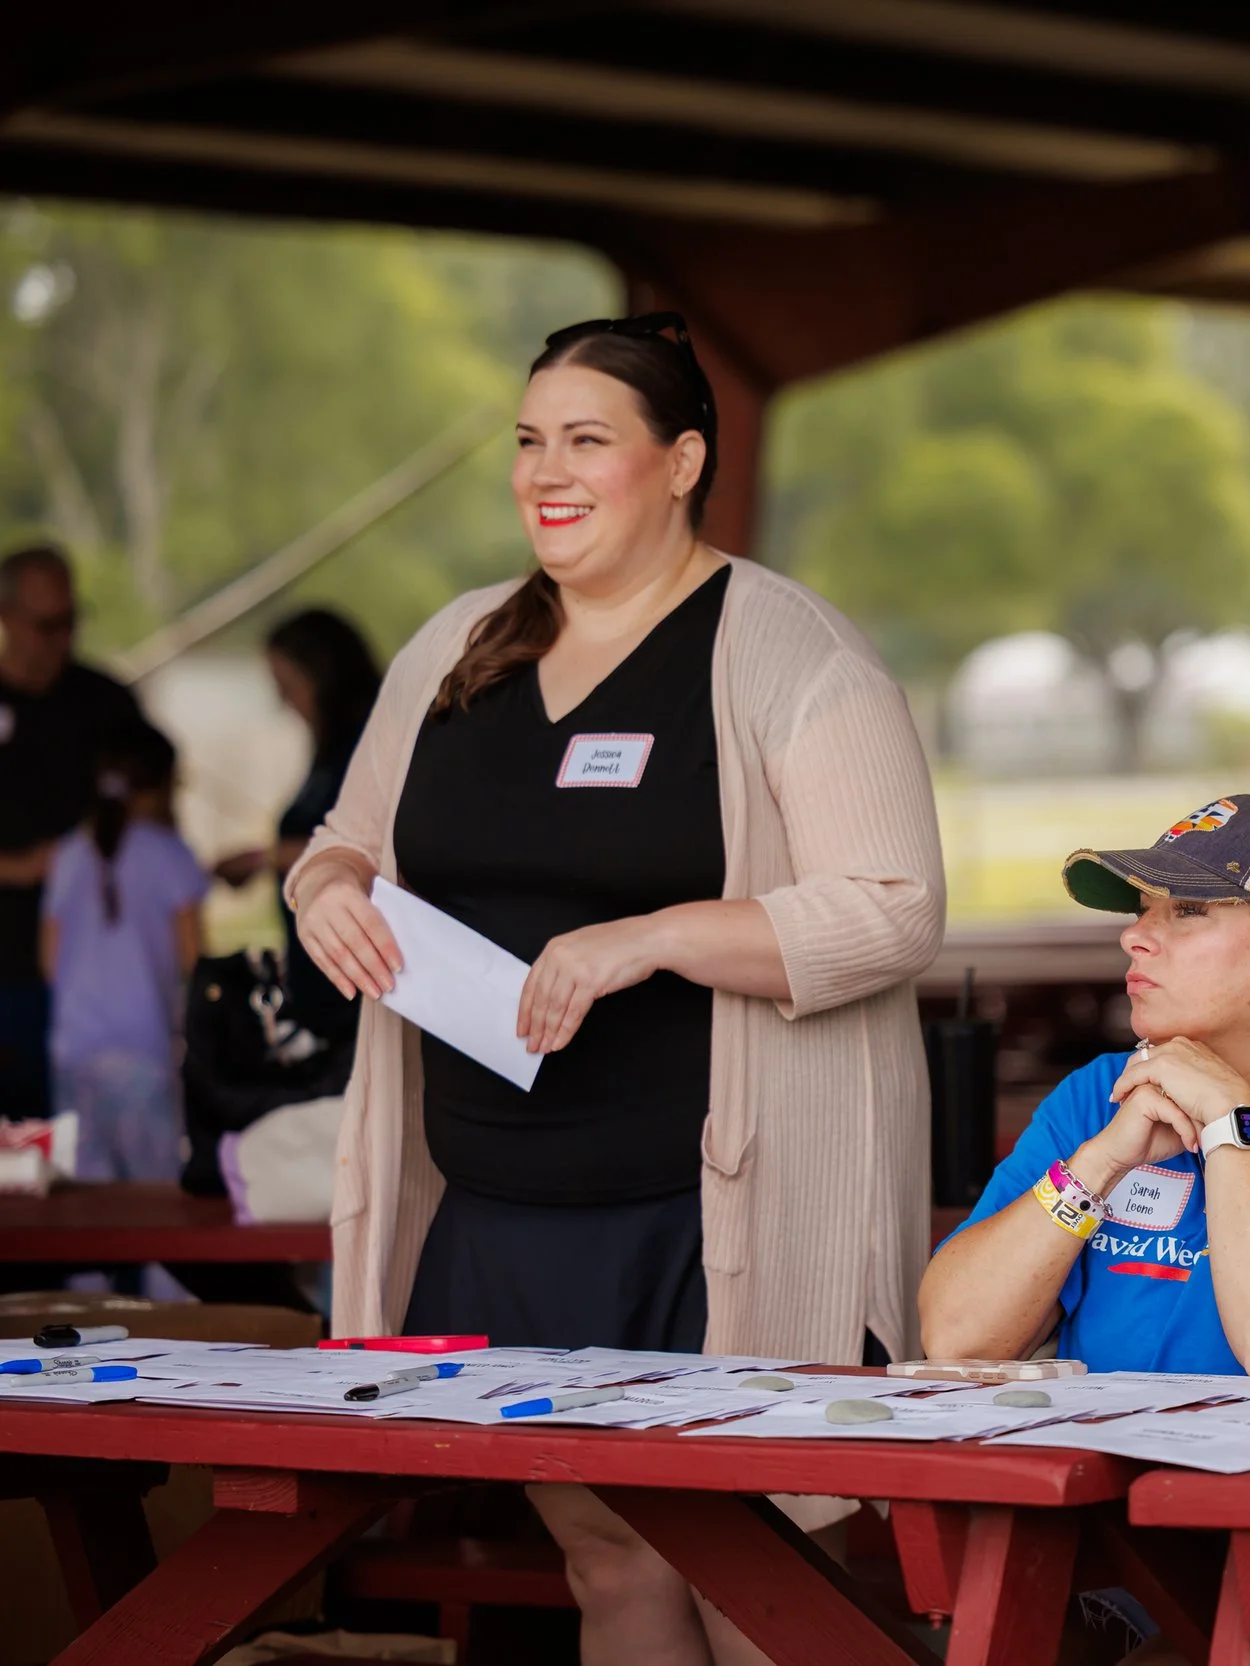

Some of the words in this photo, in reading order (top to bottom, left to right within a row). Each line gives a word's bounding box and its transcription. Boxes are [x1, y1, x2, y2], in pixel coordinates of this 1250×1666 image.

[591, 748, 622, 760] Jessica
[1130, 1181, 1161, 1200] Sarah
[1125, 1198, 1154, 1215] Leone
[1091, 1232, 1155, 1257] avid
